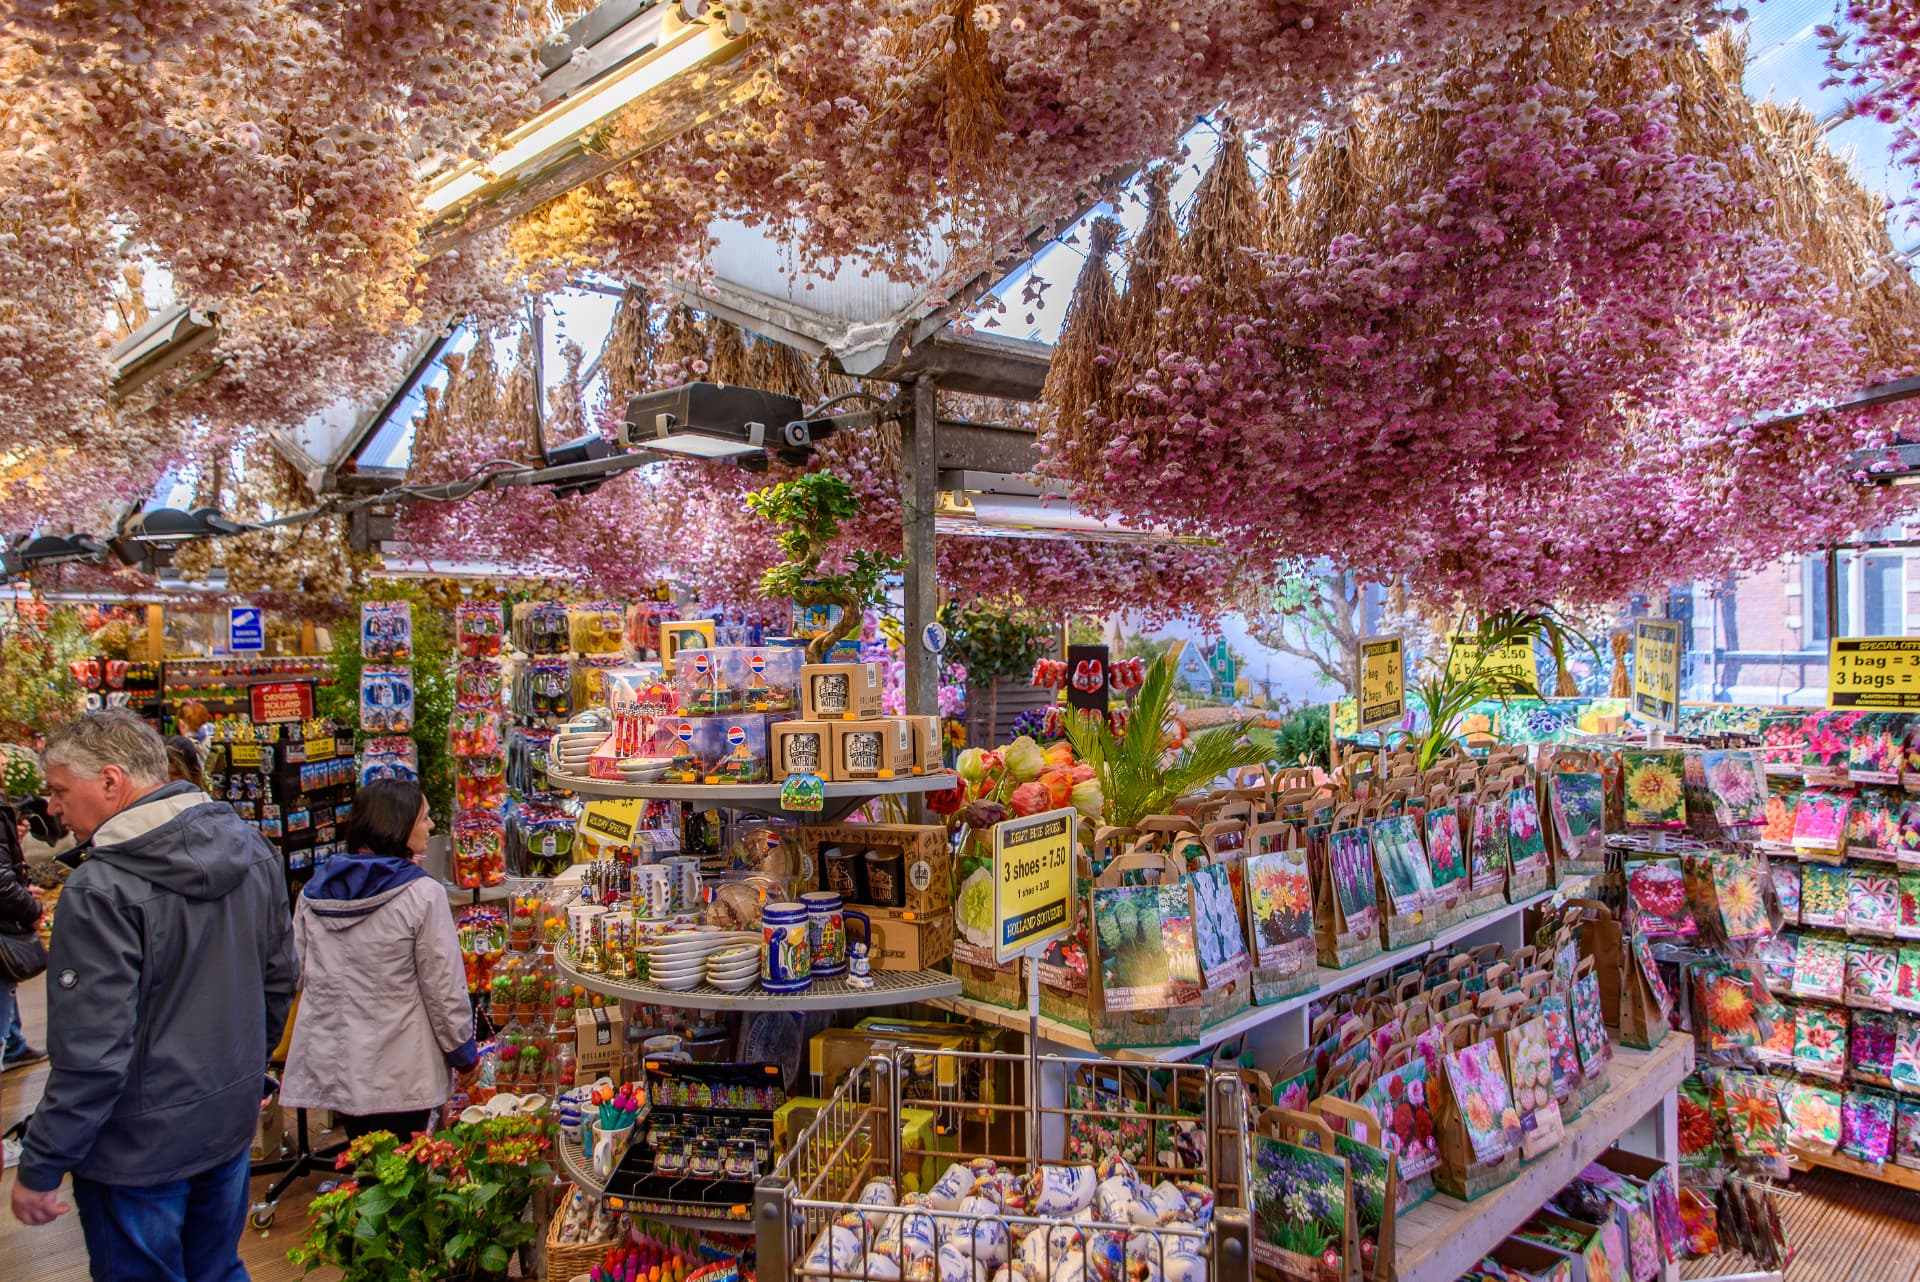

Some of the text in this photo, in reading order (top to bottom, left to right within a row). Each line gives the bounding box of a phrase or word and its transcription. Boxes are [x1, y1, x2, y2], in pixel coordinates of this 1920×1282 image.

[1859, 642, 1899, 650] SPECIAL
[1839, 656, 1847, 666] 1
[1854, 656, 1887, 669] bag
[1836, 672, 1912, 689] 3 bags =
[1362, 686, 1368, 703] 2
[264, 700, 302, 710] HOLLAND
[588, 815, 628, 837] HOLIDAY SPECIAL
[1004, 846, 1066, 883] 3 shoes = 7.50
[1017, 889, 1021, 899] 1
[1022, 885, 1035, 898] shoe
[1039, 880, 1050, 892] 3.00
[1007, 904, 1063, 939] HOLLAND SOUVENIR
[581, 1051, 611, 1060] HOLLAND
